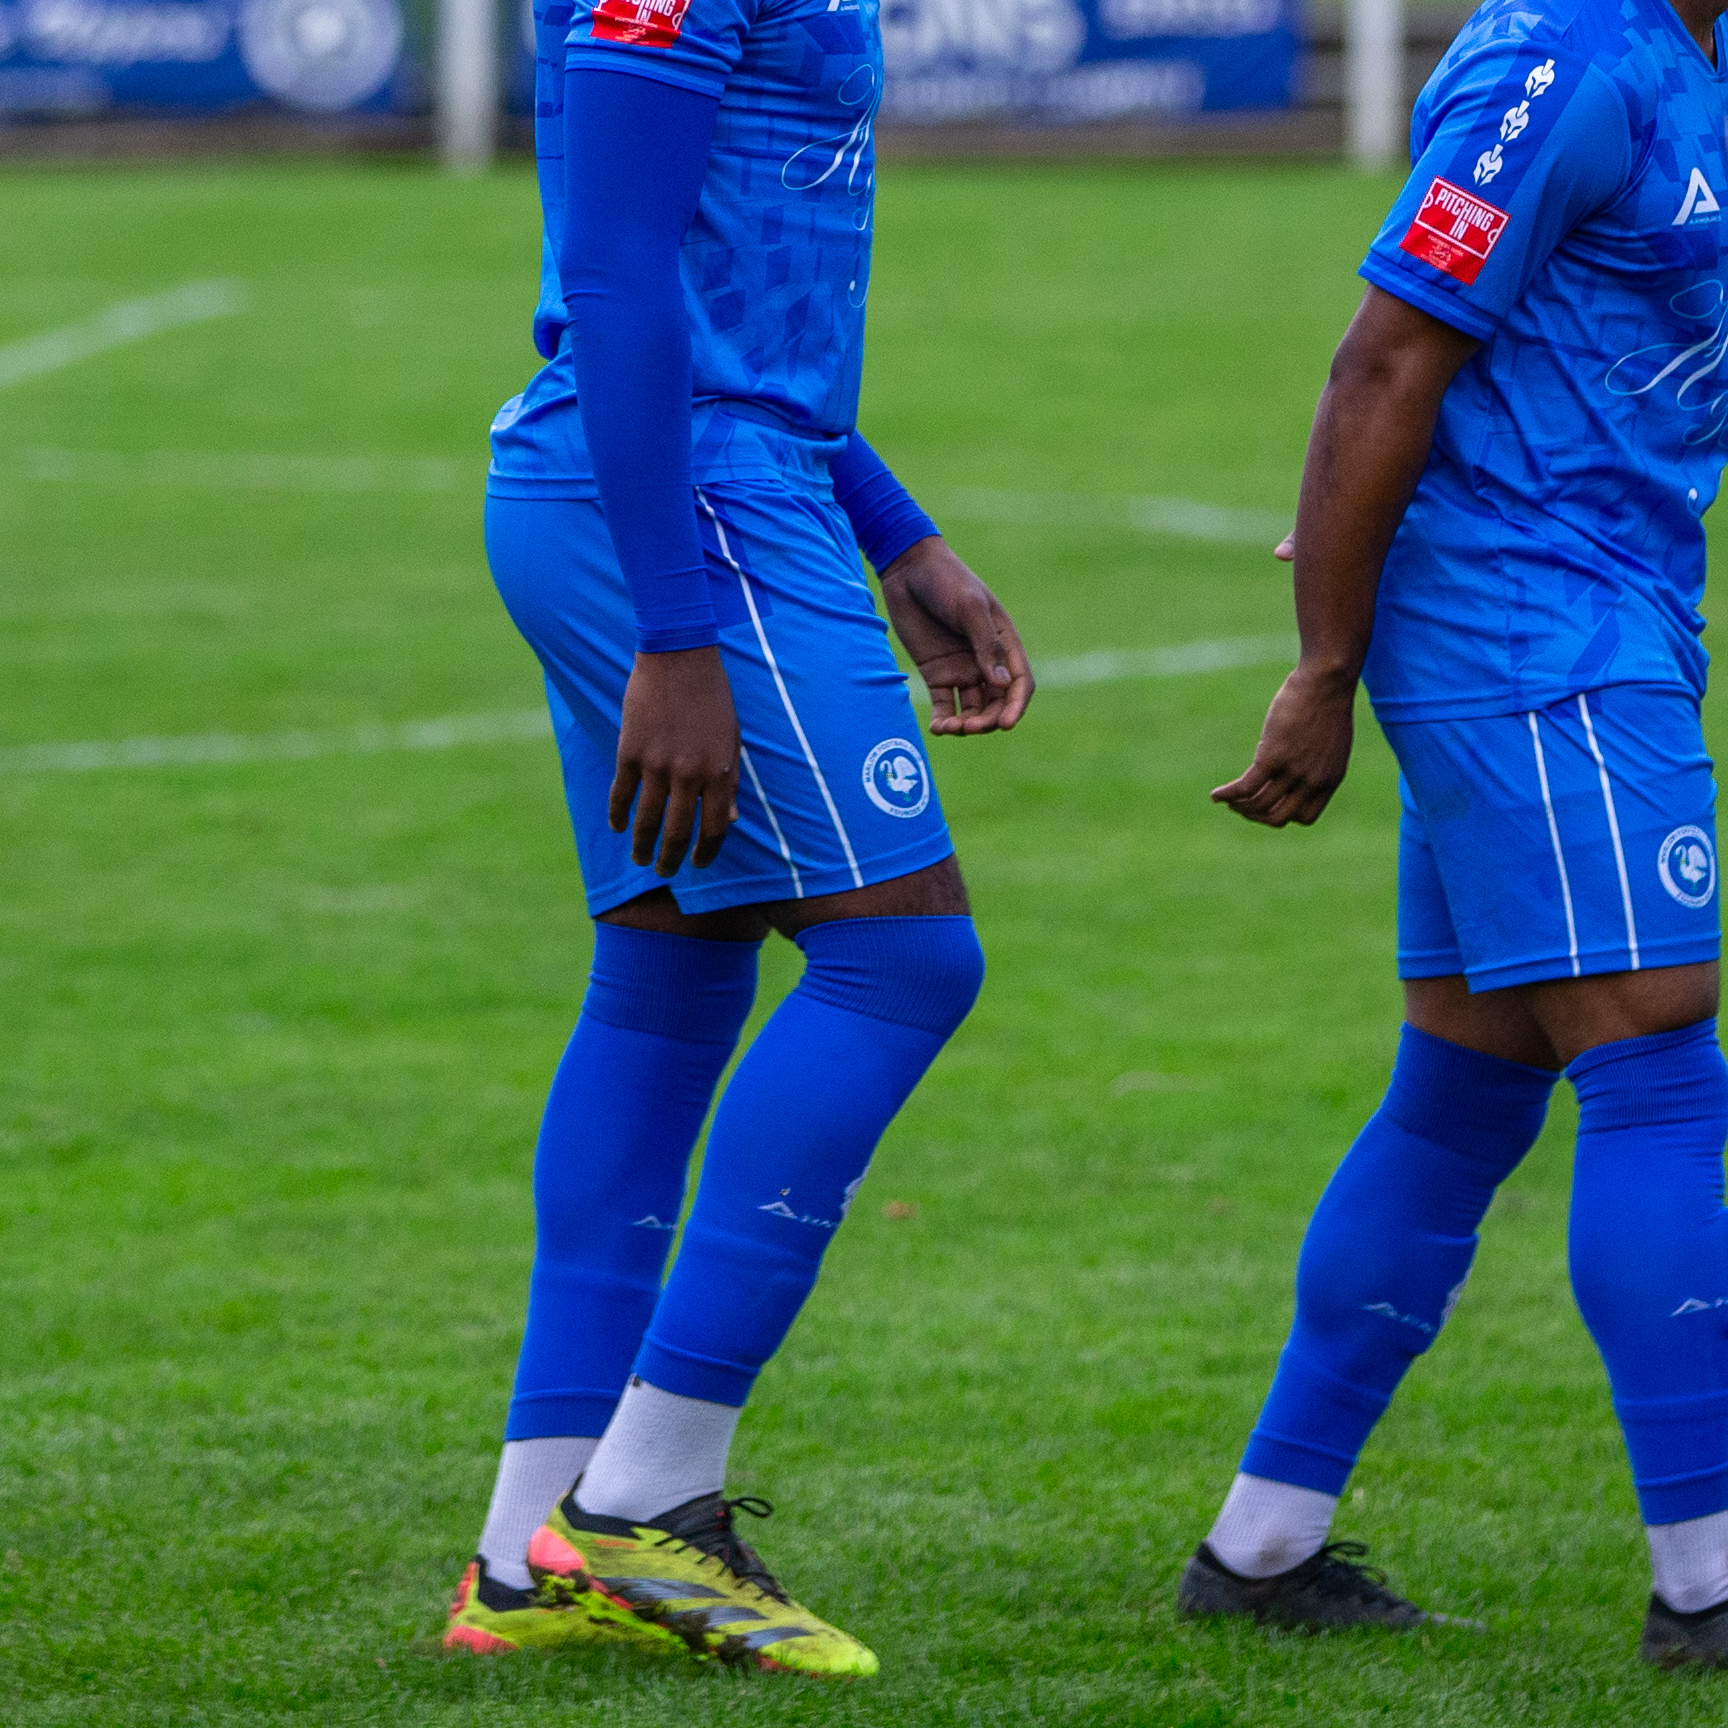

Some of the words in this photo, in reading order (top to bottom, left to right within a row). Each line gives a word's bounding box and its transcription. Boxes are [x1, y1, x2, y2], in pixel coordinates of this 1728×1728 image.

[636, 8, 652, 23] IN
[1434, 187, 1495, 232] PITCHING
[1449, 220, 1470, 241] IN
